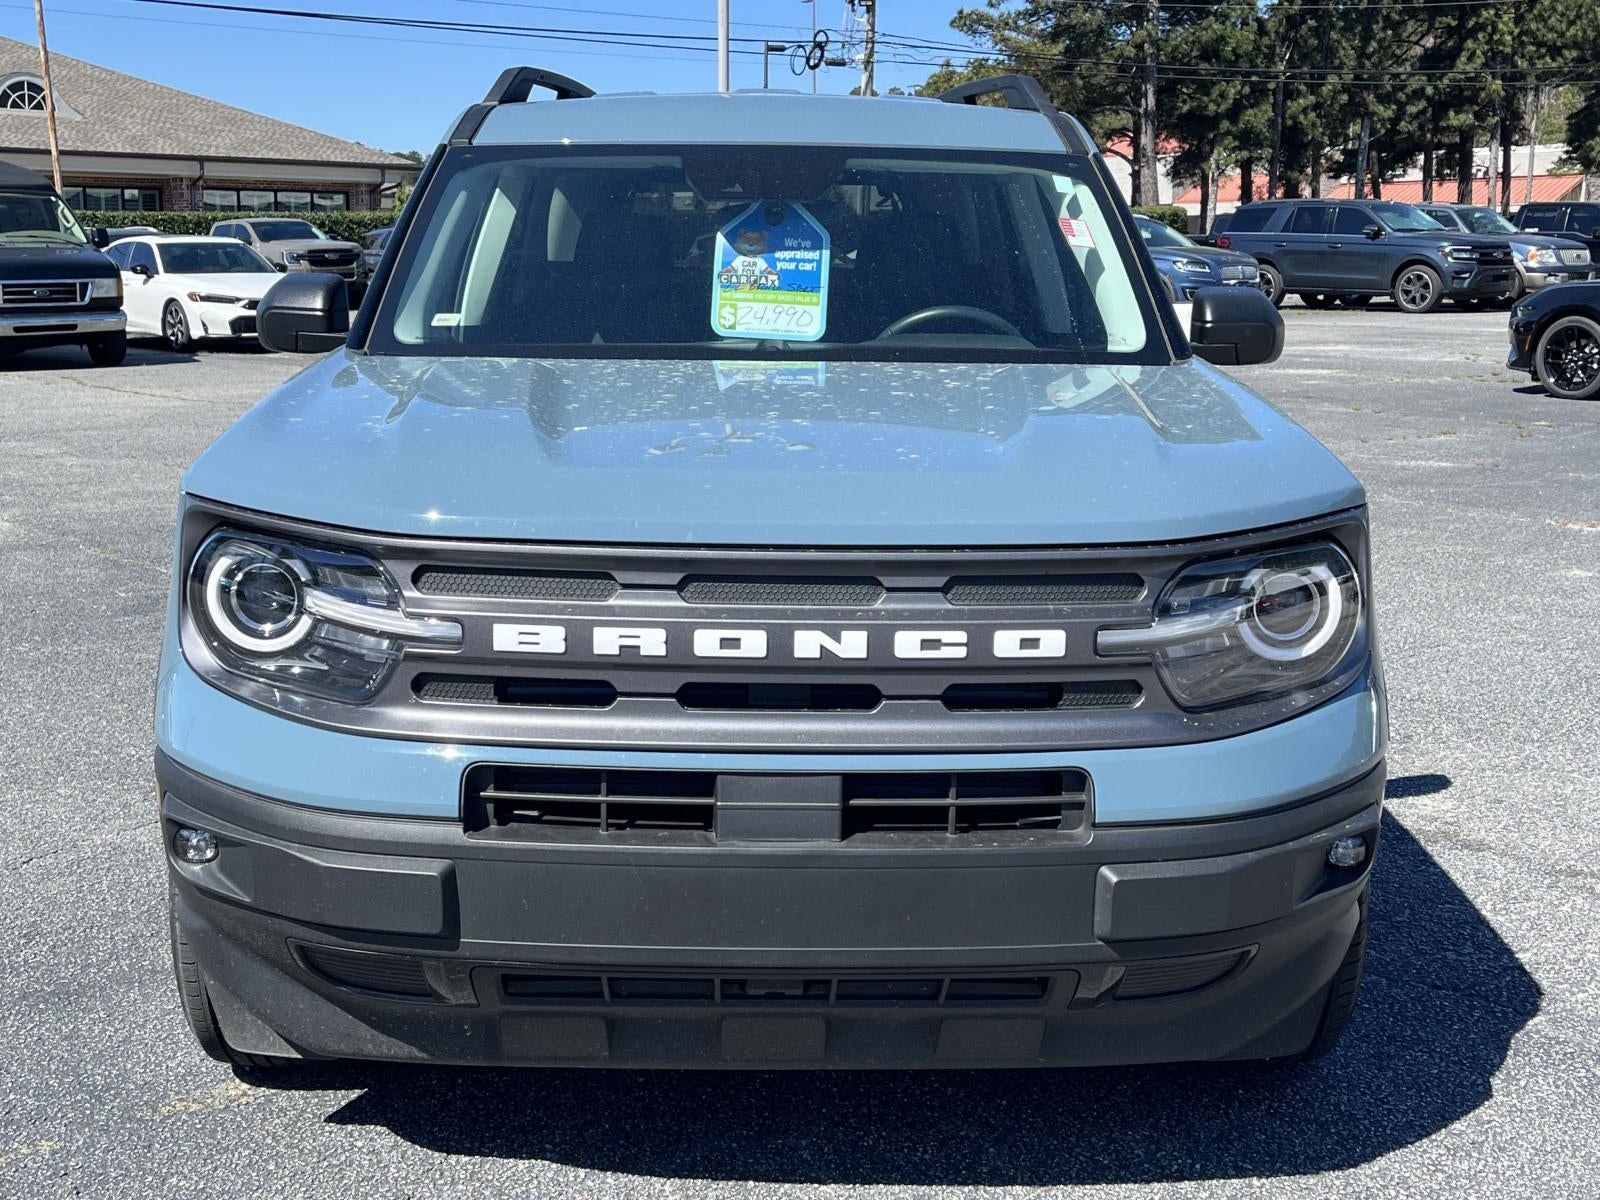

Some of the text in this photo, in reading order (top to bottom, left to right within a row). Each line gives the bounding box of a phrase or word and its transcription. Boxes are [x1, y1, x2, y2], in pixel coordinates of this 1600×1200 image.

[784, 237, 811, 248] We've
[774, 250, 819, 260] appraised
[741, 260, 757, 268] CAR
[776, 261, 817, 271] your car!
[719, 273, 779, 286] CARFAX
[493, 622, 1066, 659] BRONCO
